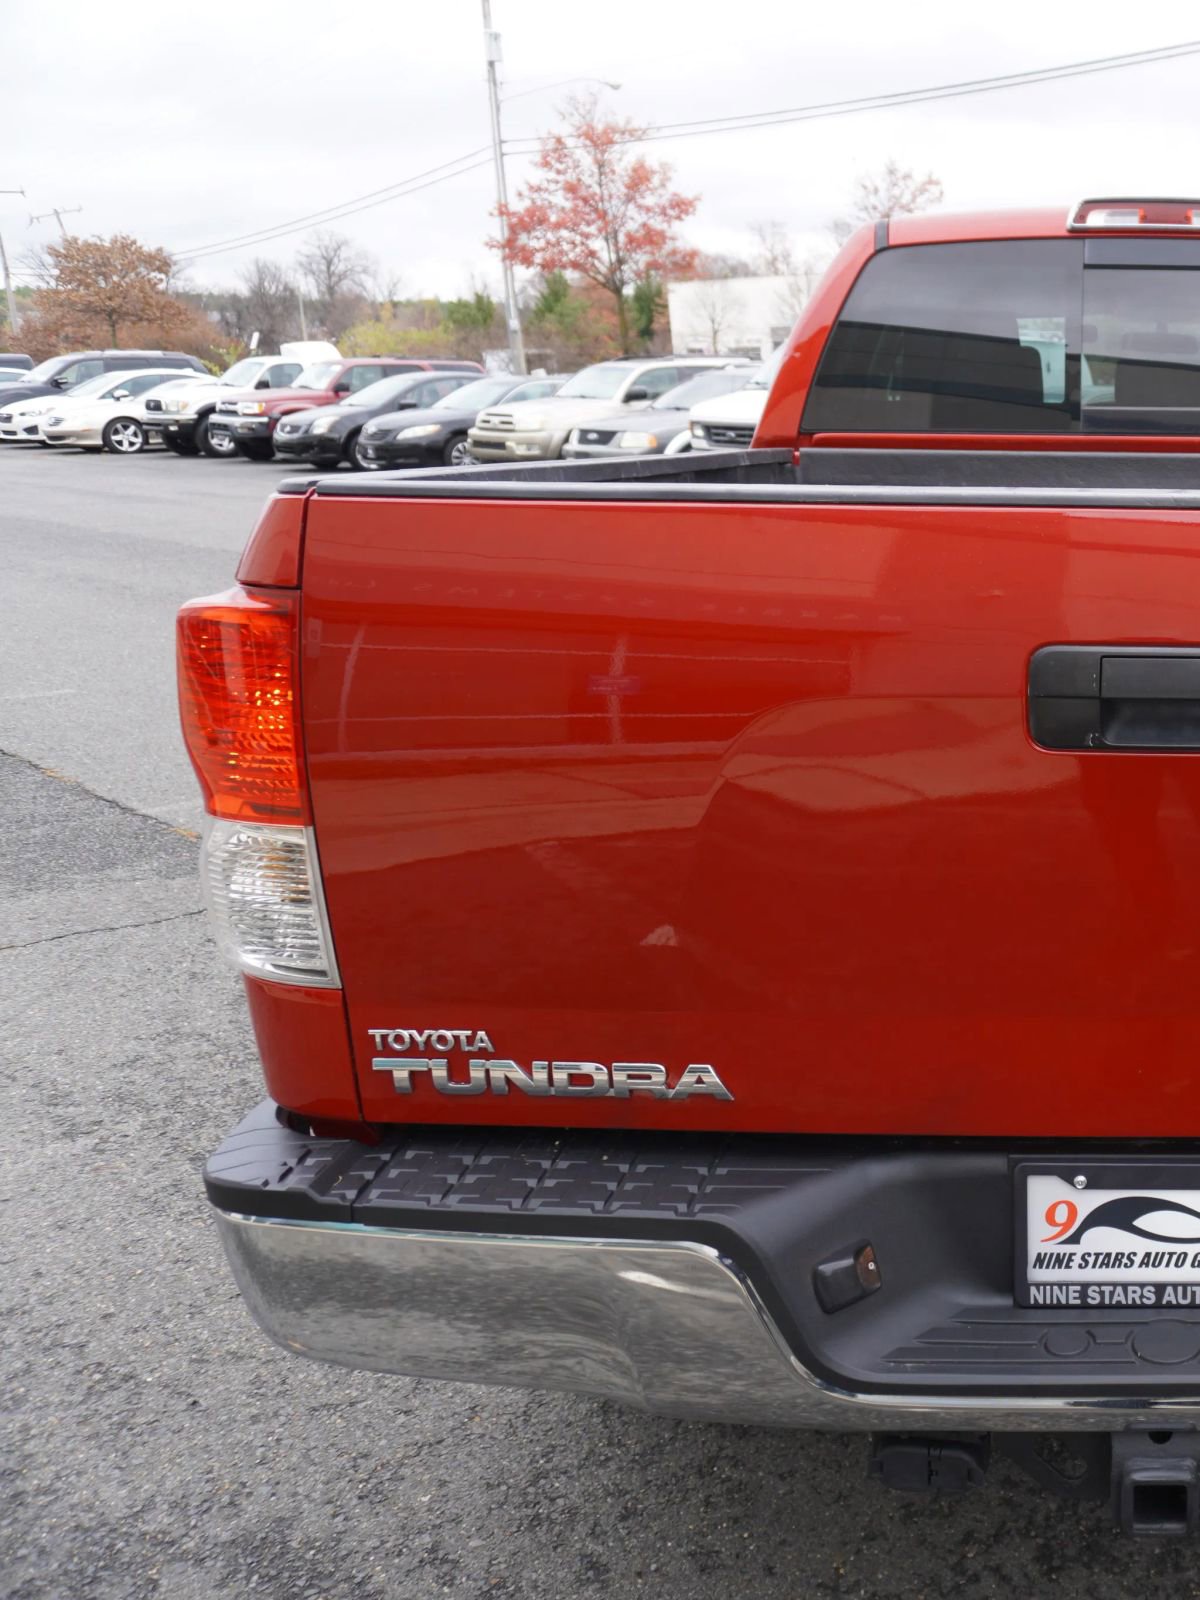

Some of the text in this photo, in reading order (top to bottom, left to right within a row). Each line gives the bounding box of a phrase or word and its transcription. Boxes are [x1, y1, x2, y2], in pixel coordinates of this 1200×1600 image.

[368, 1029, 495, 1052] TOYOTA
[372, 1058, 734, 1101] TUNDRA
[1040, 1199, 1078, 1243] 9
[1032, 1252, 1075, 1270] NINE
[1080, 1251, 1138, 1269] STARS
[1138, 1251, 1188, 1269] AUTO
[1029, 1286, 1081, 1305] NINE
[1087, 1286, 1156, 1305] STARS
